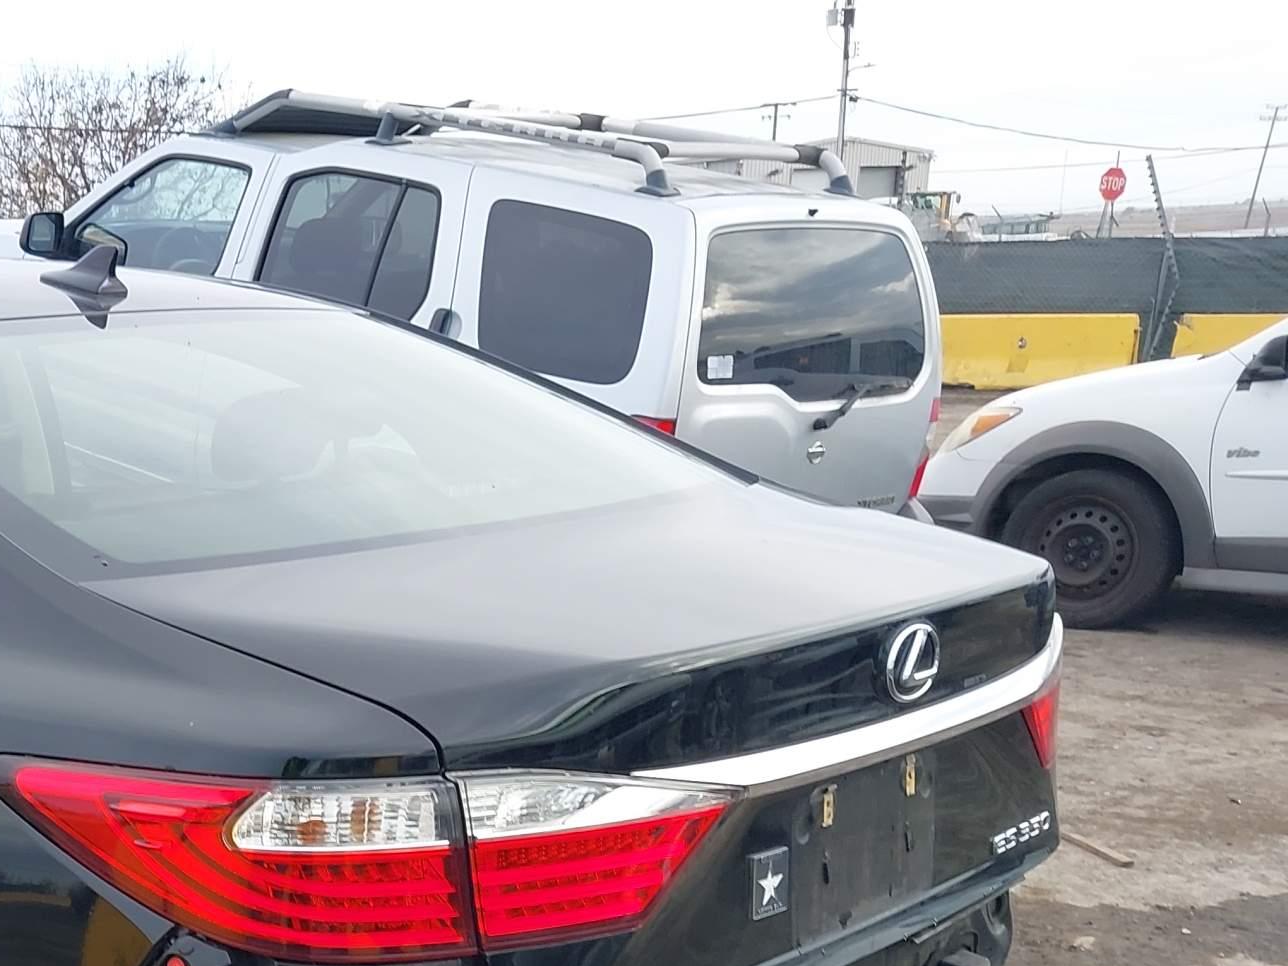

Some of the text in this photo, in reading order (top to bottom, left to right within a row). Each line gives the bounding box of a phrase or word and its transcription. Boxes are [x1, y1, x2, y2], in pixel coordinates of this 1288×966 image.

[1101, 175, 1125, 191] STOP
[993, 811, 1051, 854] ES 350
